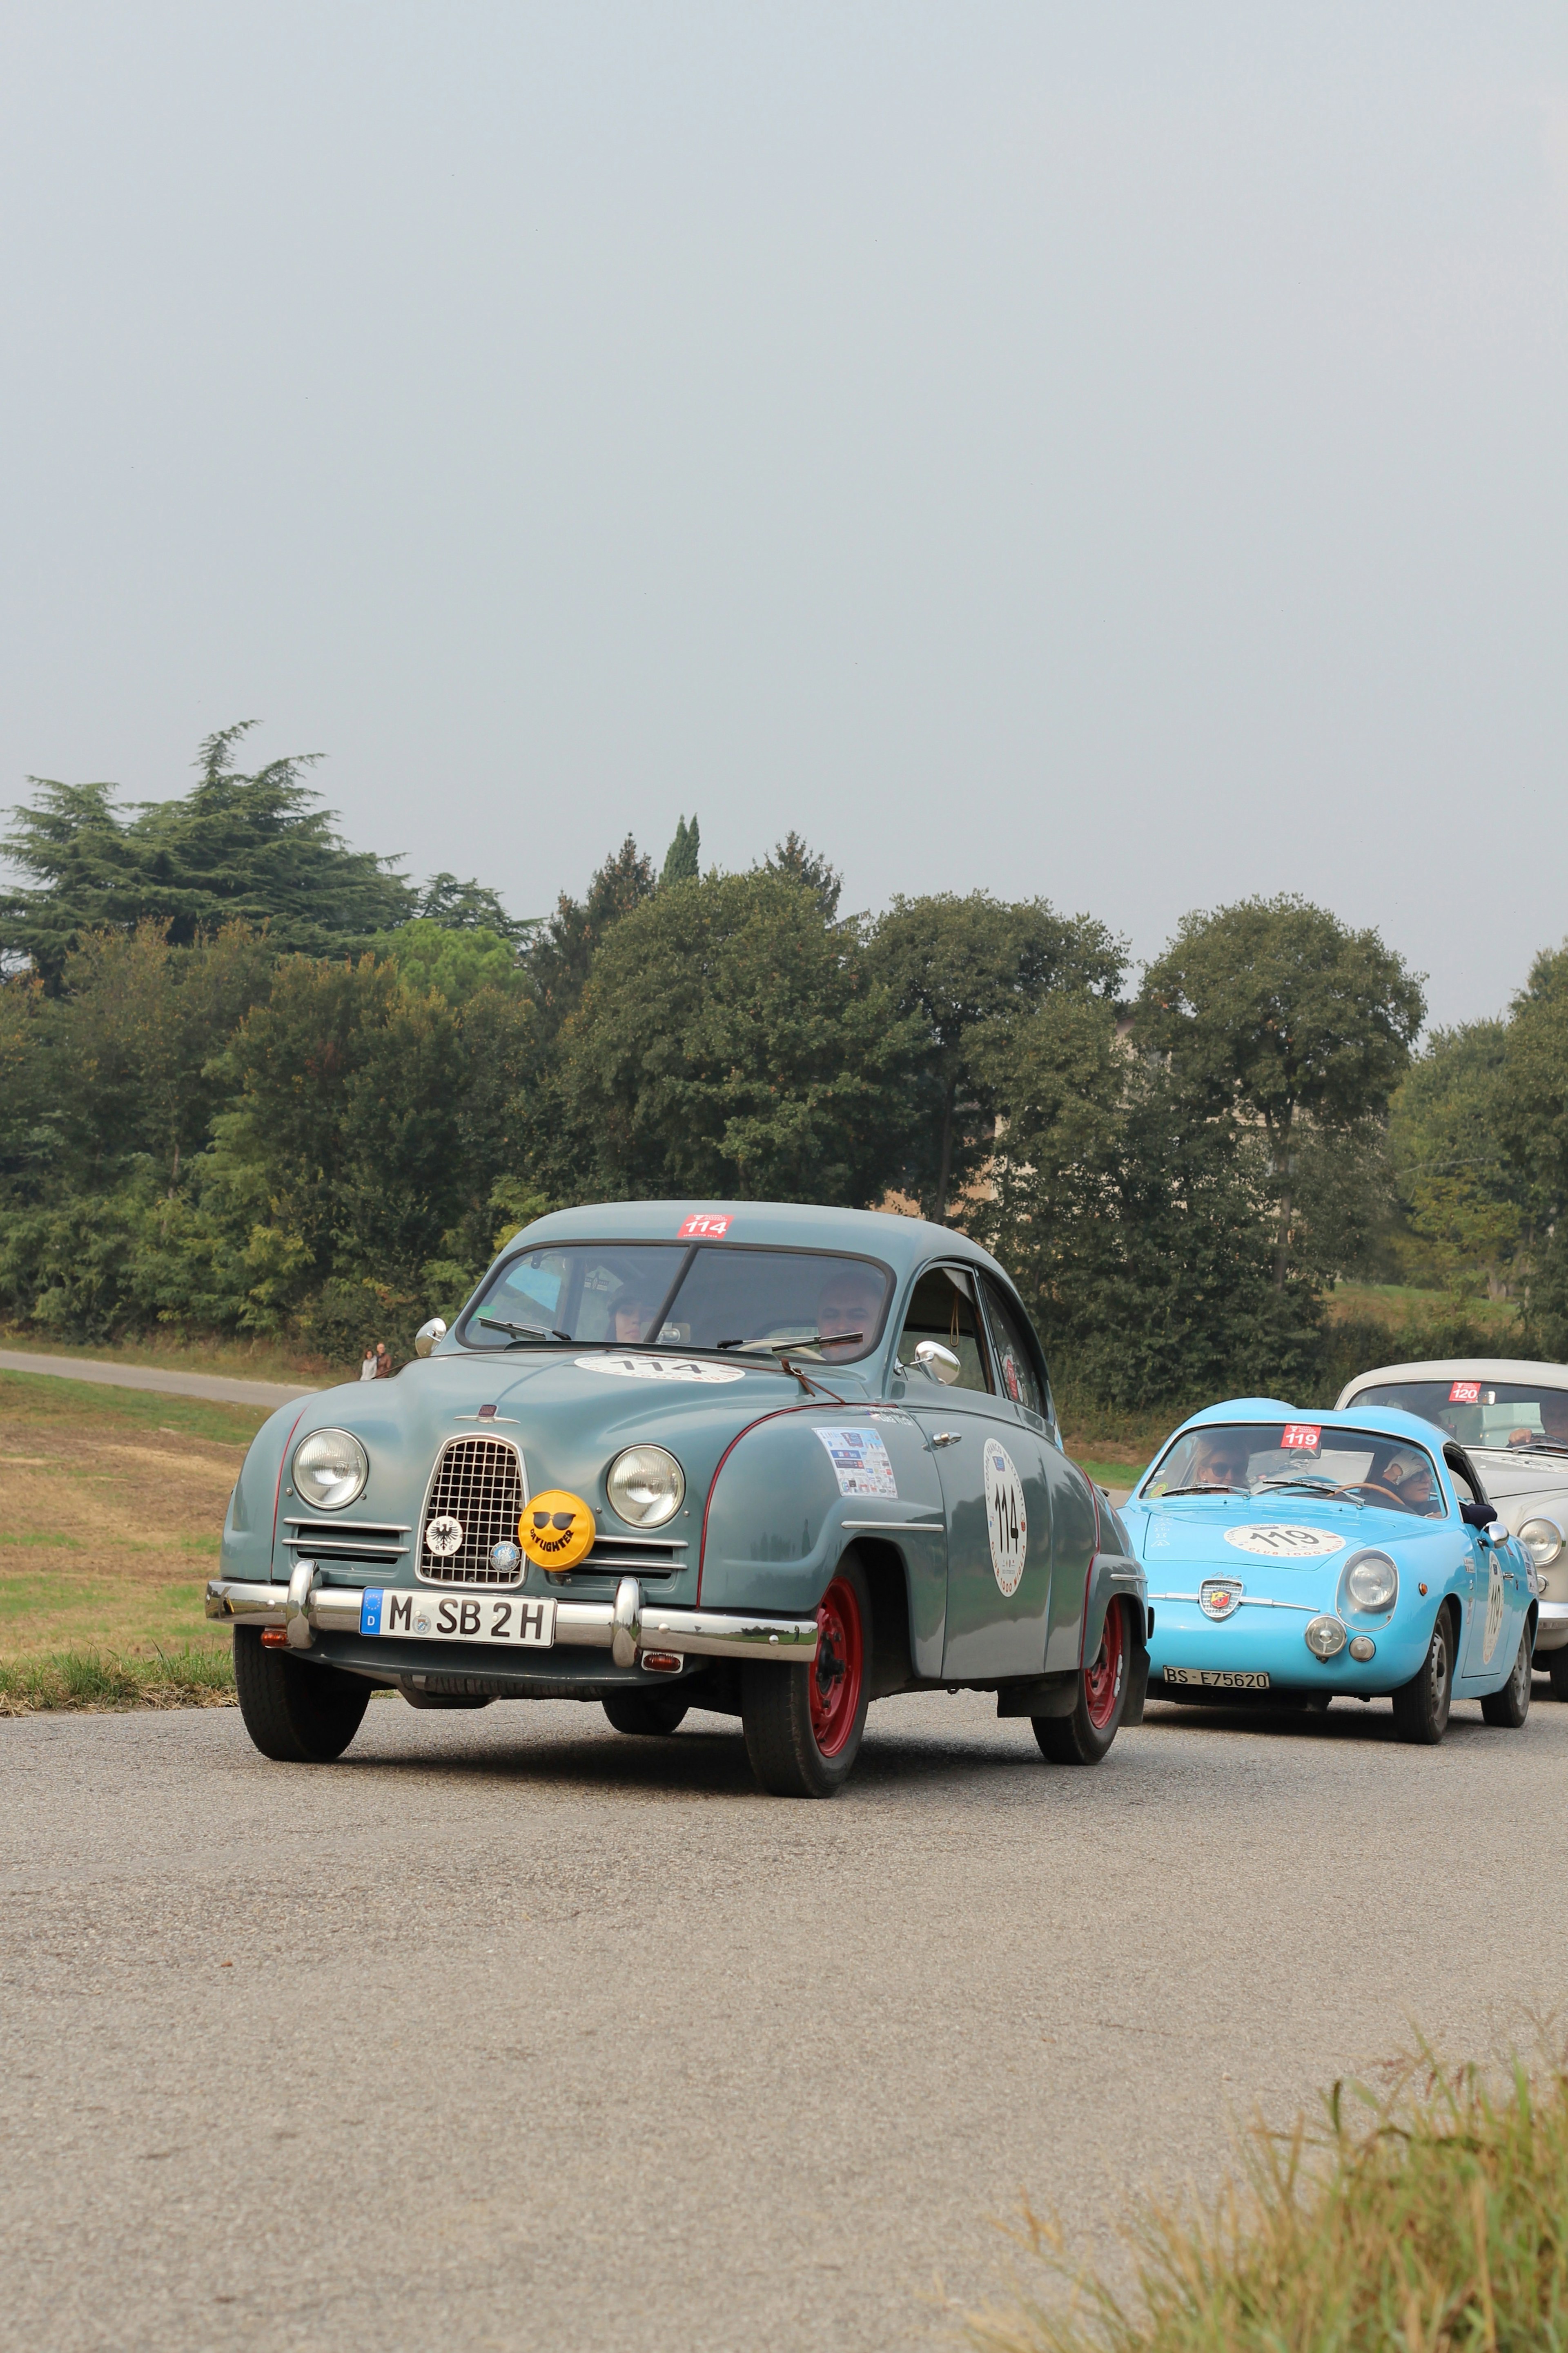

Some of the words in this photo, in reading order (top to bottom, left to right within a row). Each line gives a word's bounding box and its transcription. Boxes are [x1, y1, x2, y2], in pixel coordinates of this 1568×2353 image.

[686, 1220, 727, 1234] 114
[610, 1360, 707, 1374] 114
[1453, 1389, 1477, 1399] 120
[1285, 1433, 1317, 1445] 119
[995, 1483, 1019, 1554] 114
[1281, 1524, 1330, 1534] MAZZOTTI
[530, 1528, 575, 1552] DAYLIGHTER
[1250, 1530, 1319, 1547] 119
[1248, 1547, 1278, 1555] CLUB
[1000, 1577, 1012, 1592] 1000
[1014, 1545, 1025, 1588] MIGLIA
[368, 1616, 375, 1626] D
[389, 1595, 412, 1630] M
[437, 1598, 481, 1634] SB
[1166, 1668, 1188, 1683] BS
[1200, 1671, 1267, 1688] E75620
